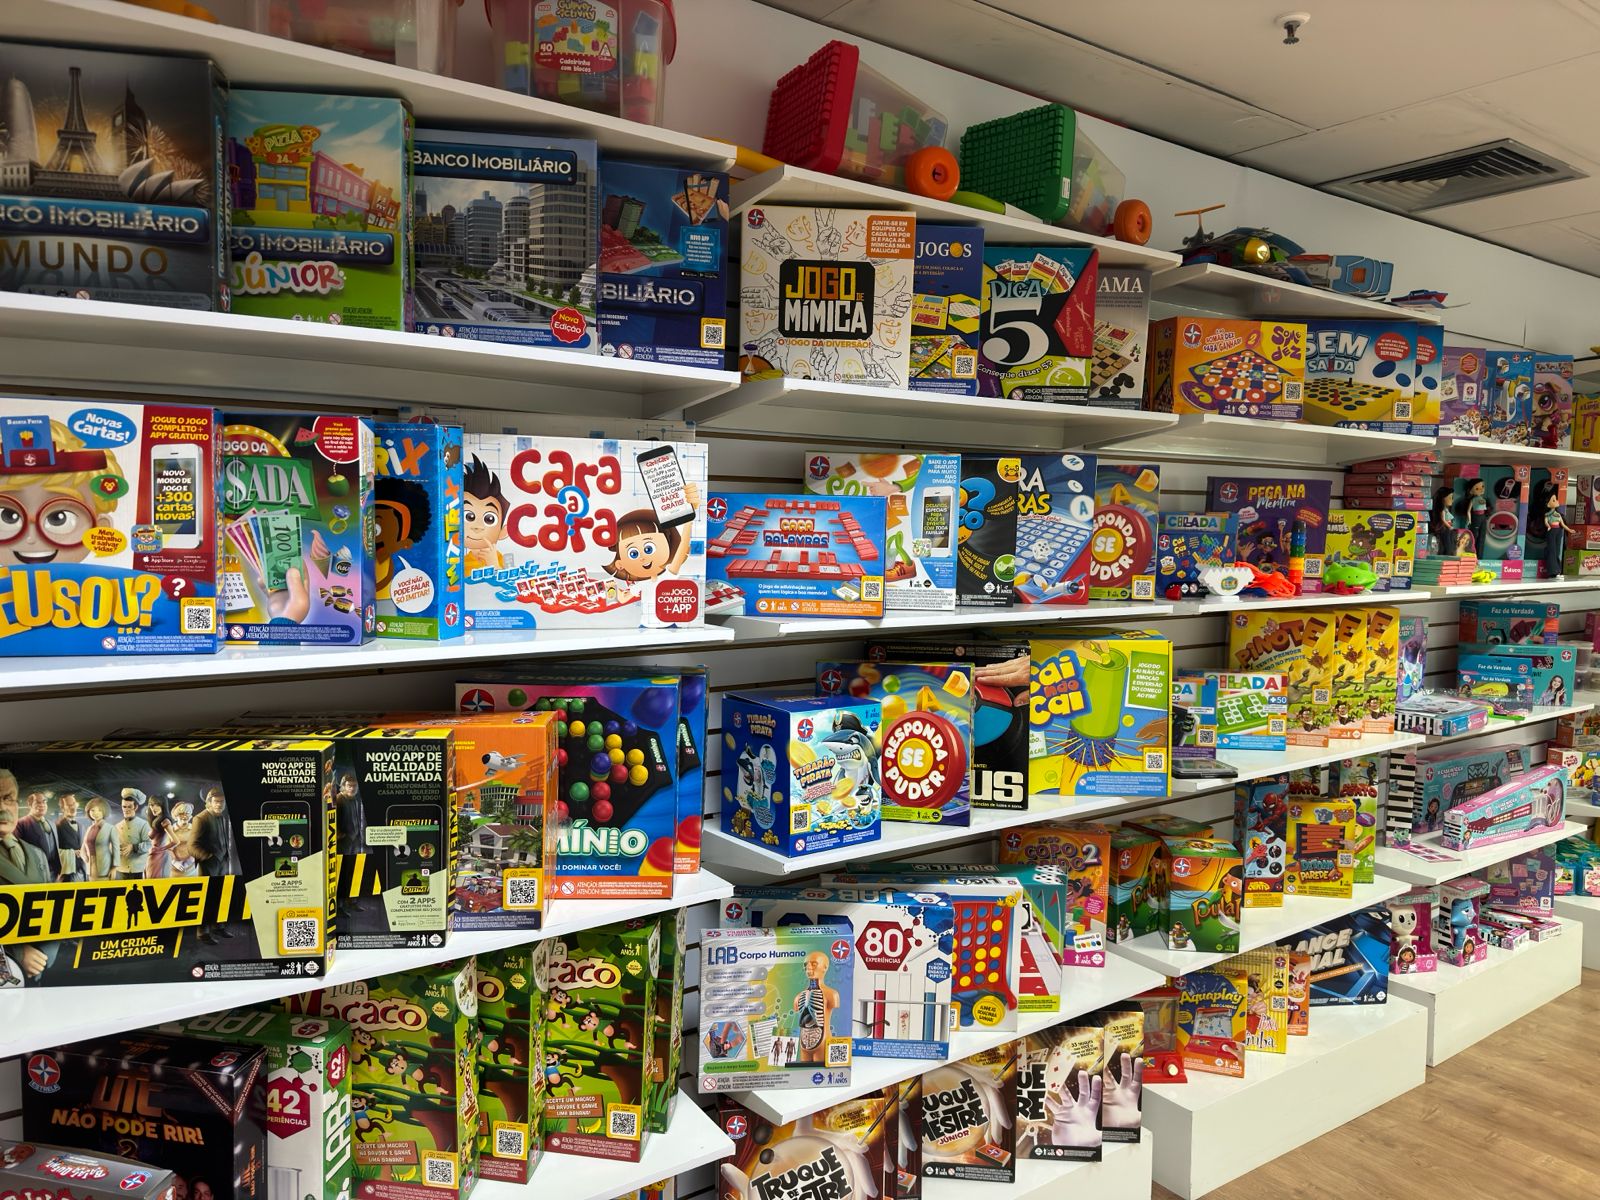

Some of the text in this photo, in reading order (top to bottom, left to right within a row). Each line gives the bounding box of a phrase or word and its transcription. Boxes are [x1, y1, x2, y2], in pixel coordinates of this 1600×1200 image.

[264, 130, 303, 152] PIZZA
[413, 149, 571, 174] BANCO IMOBILIÁRIO
[50, 204, 200, 234] IMOBILIÁRIO
[260, 235, 385, 256] IMOBILIÁRIO
[0, 239, 169, 276] MUNDO
[785, 266, 857, 300] JOGO
[987, 279, 1043, 298] DIGA
[558, 313, 579, 324] Nova
[784, 299, 867, 334] MÍMICA
[554, 322, 581, 335] Edição
[982, 296, 1049, 366] 5
[786, 339, 811, 347] JOGO
[812, 339, 824, 347] DA
[825, 338, 871, 348] DIVERSÃO!
[977, 363, 1016, 379] Consegue
[1018, 367, 1040, 378] dizer
[1308, 355, 1355, 373] SAÍDA
[86, 412, 122, 429] Novas
[150, 416, 177, 424] JOGUE
[185, 417, 208, 425] JOGO
[152, 424, 197, 432] COMPLETO
[73, 420, 130, 443] Cartas!
[150, 431, 209, 441] APP GRATUITO
[253, 441, 269, 452] DA
[156, 492, 193, 502] +300
[1287, 484, 1306, 498] NA
[155, 511, 195, 520] novas!
[157, 503, 194, 512] cartas
[1094, 536, 1116, 553] SE
[394, 581, 430, 597] PODE FALAR
[670, 588, 693, 596] JOGO
[657, 596, 697, 604] COMPLETO
[663, 604, 692, 613] +APP
[1235, 616, 1328, 666] PINOTE
[885, 720, 949, 762] RESPONDA
[305, 761, 316, 769] DE
[366, 752, 442, 762] NOVO APP DE
[900, 747, 925, 768] SE
[372, 762, 442, 771] REALIDADE
[793, 756, 836, 779] TUBARÃO
[261, 776, 317, 784] AUMENTADA
[364, 772, 443, 782] AUMENTADA
[800, 769, 833, 787] PIRATA
[885, 767, 946, 800] PUDER
[1024, 843, 1098, 863] COPO 2
[0, 883, 203, 940] DETETIVE
[100, 936, 158, 950] UM CRIME
[864, 927, 903, 957] 80
[92, 945, 164, 961] DESAFIADOR
[707, 946, 806, 966] LAB Corpo Humano
[865, 956, 901, 964] EXPERIÊNCIAS
[1180, 987, 1244, 1003] Aquaplay
[267, 1088, 301, 1115] 42
[51, 1107, 205, 1146] NÃO PODE RIR!
[939, 1128, 970, 1146] JÚNIOR
